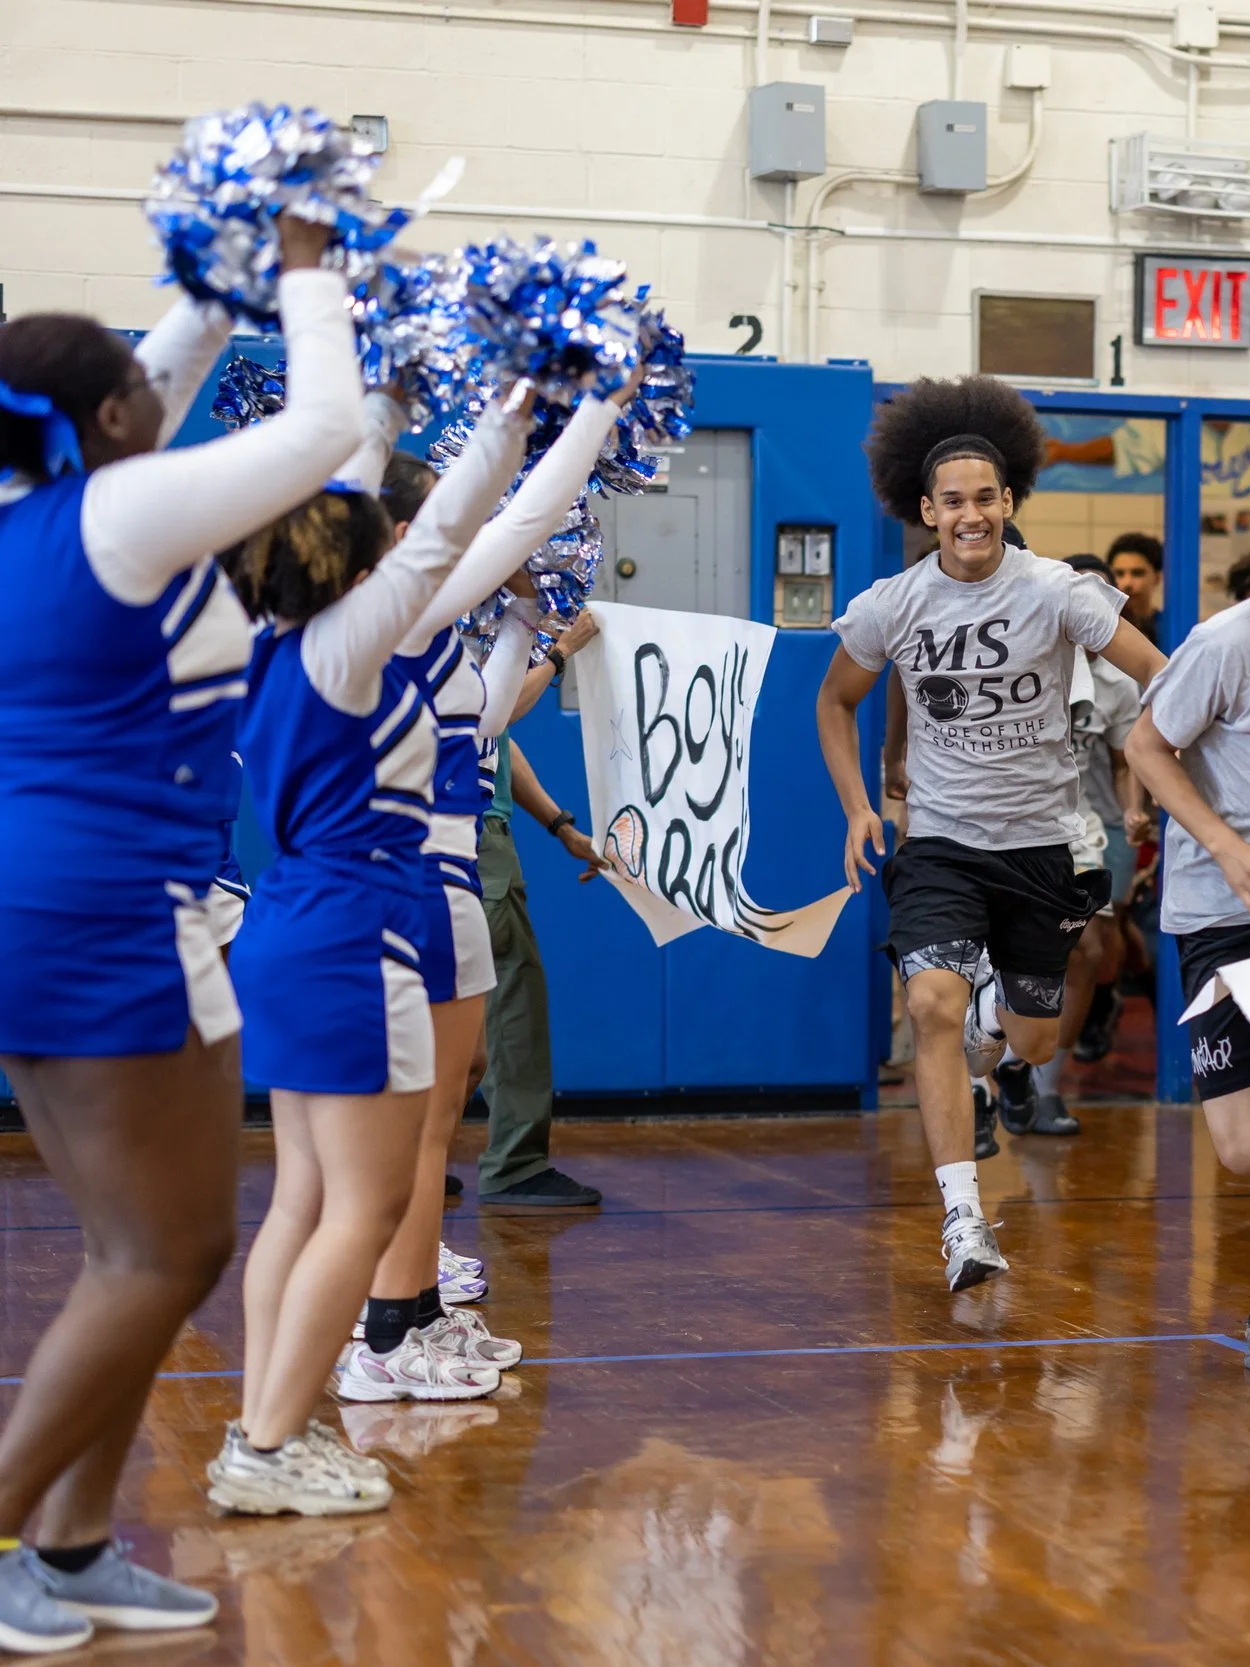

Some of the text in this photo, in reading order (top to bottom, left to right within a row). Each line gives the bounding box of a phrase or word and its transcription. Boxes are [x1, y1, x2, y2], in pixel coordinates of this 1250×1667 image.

[1155, 267, 1248, 341] EXIT
[728, 315, 763, 355] 2
[1110, 335, 1125, 386] 1
[910, 618, 1011, 672] MS
[970, 671, 1042, 721] 50
[980, 725, 1006, 738] OF
[1013, 718, 1045, 735] THE
